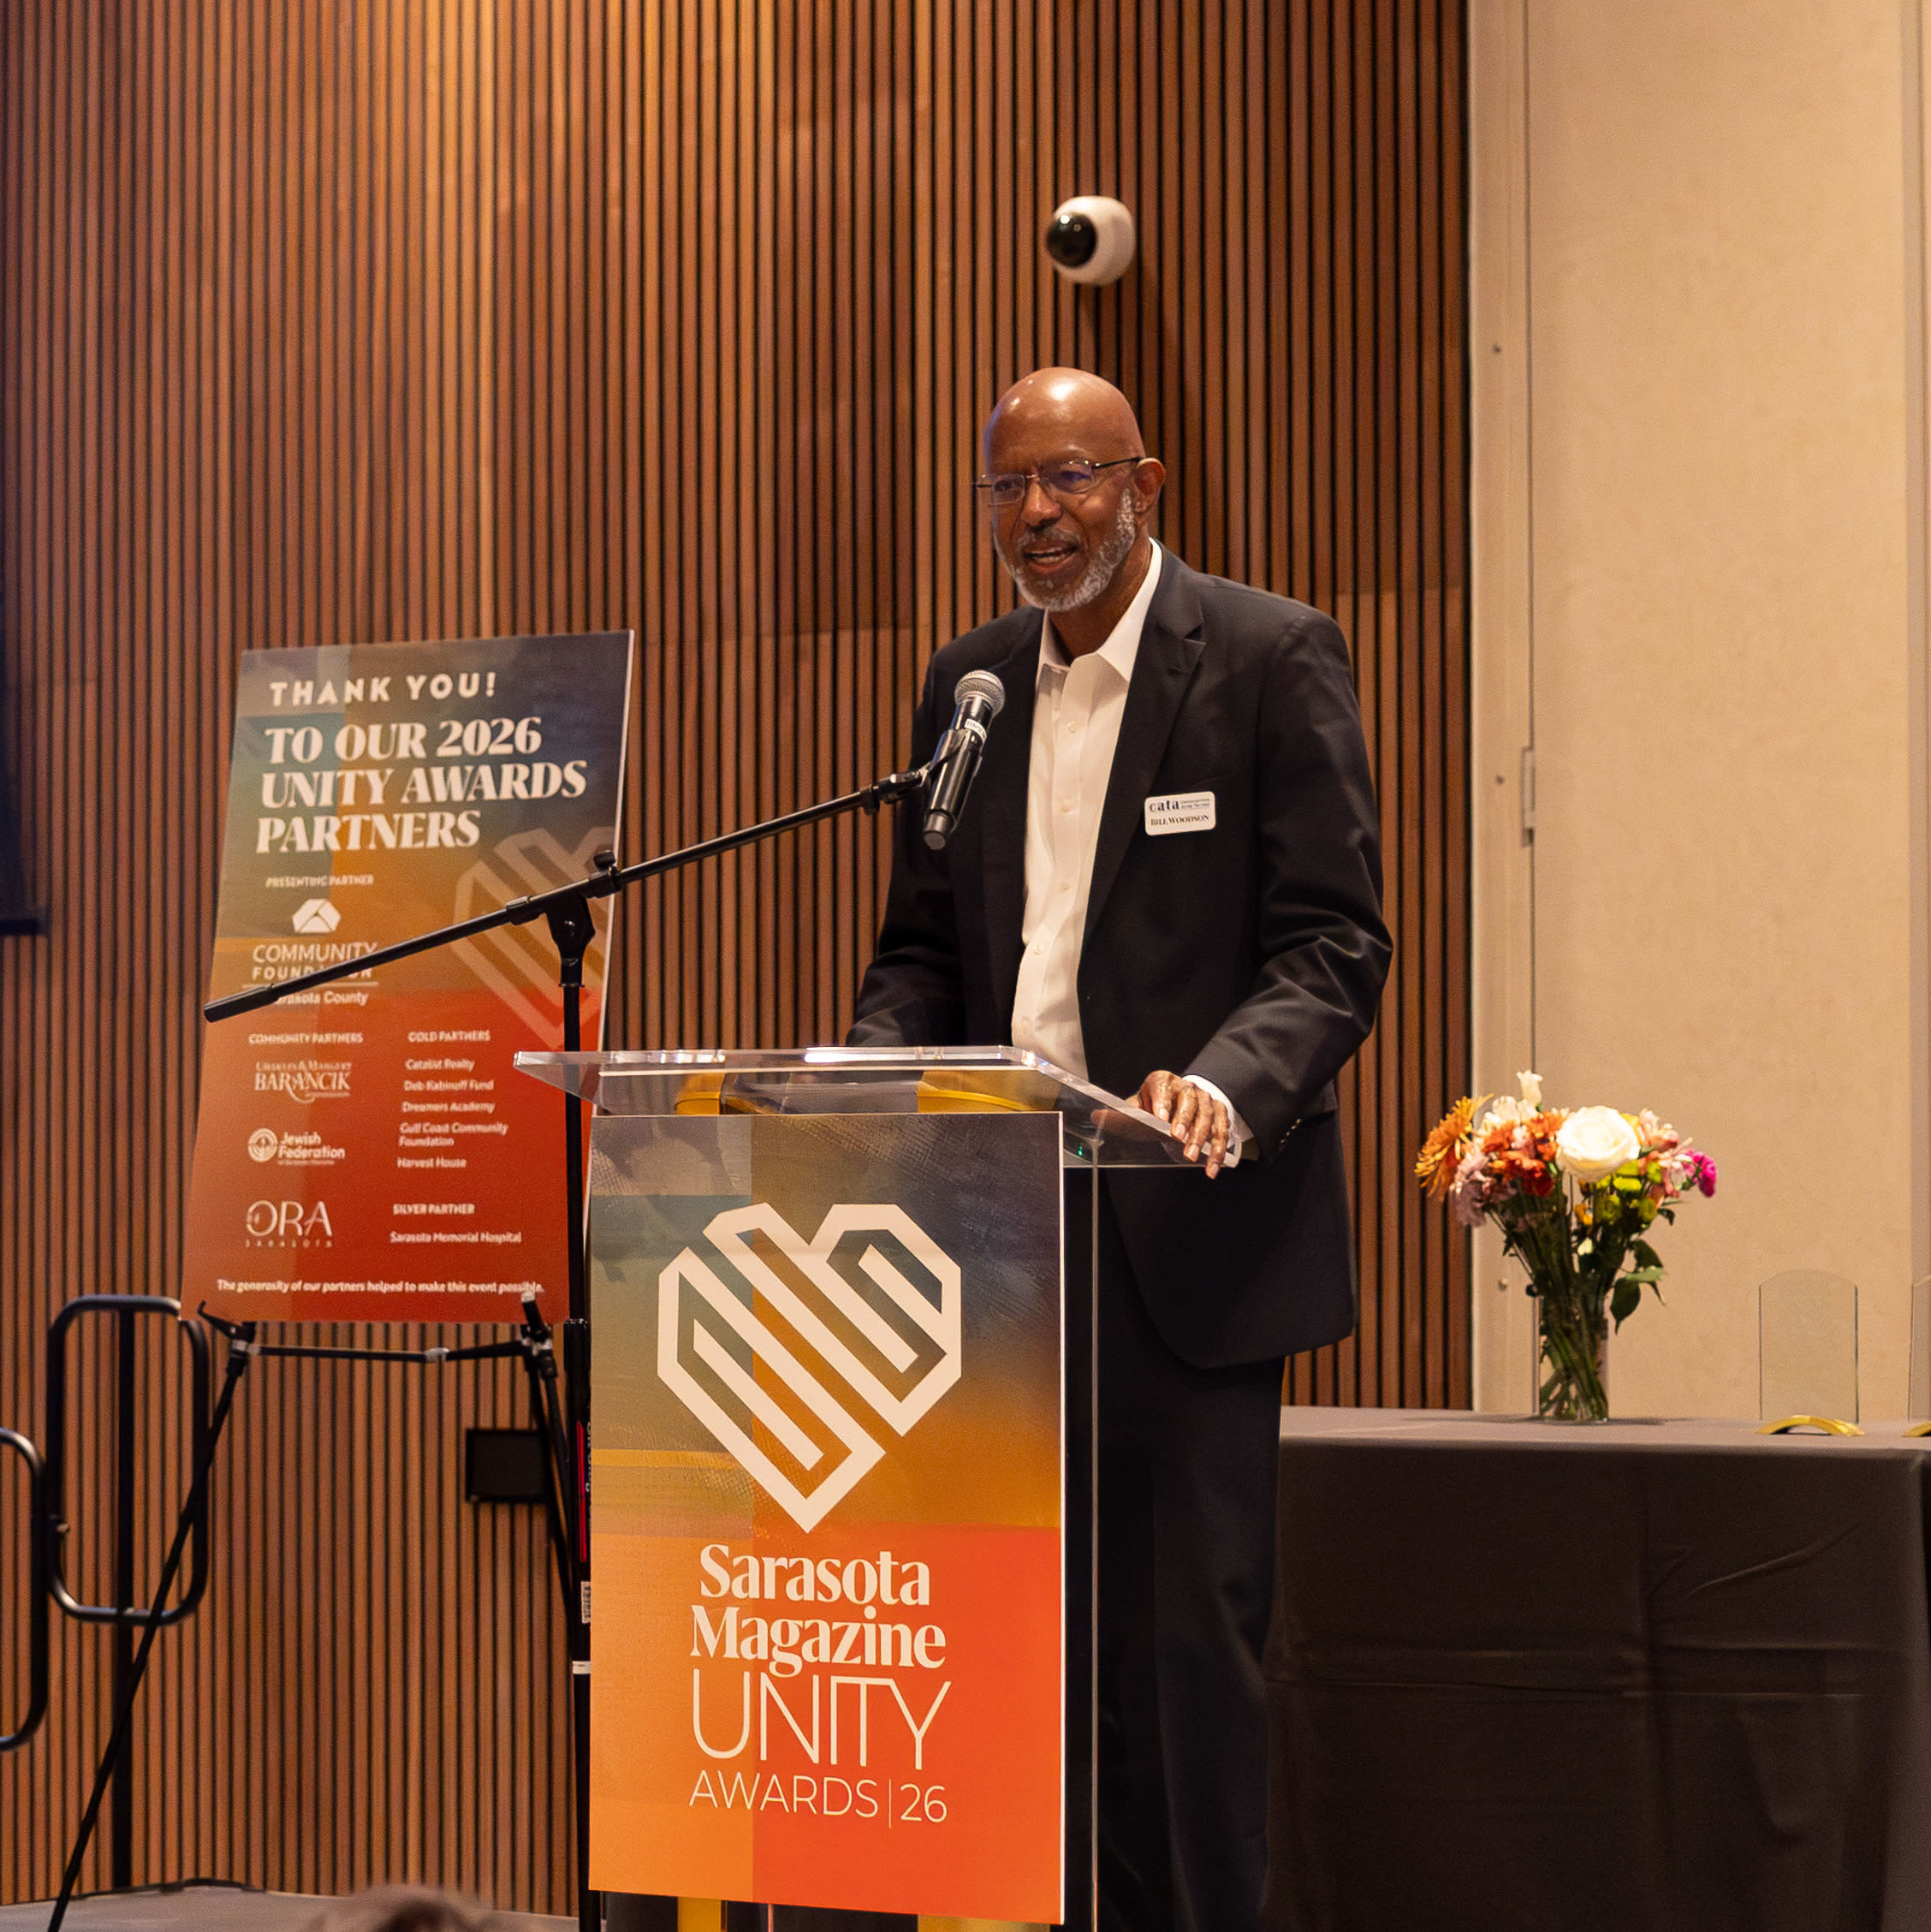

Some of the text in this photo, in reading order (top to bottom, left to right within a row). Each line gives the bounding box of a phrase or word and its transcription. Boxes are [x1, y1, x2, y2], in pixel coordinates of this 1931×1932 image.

[270, 672, 496, 706] THANK YOU!
[264, 716, 542, 764] TO OUR 2026
[262, 760, 587, 808] UNITY AWARDS
[257, 810, 480, 853] PARTNERS
[330, 874, 374, 886] PARTNER
[253, 942, 377, 963] COMMUNITY
[323, 990, 369, 1006] County
[248, 1031, 364, 1044] COMMUNITY PARTNERS
[407, 1030, 490, 1043] GOLD PARTNERS
[254, 1070, 351, 1103] BARANCIK
[469, 1079, 494, 1091] Fund
[449, 1101, 496, 1114] Academy
[399, 1121, 509, 1136] Gulf Coast Community
[281, 1131, 322, 1145] Jewish
[398, 1136, 455, 1147] Foundation
[278, 1145, 346, 1159] Federation
[397, 1156, 467, 1168] Harvest House
[393, 1204, 475, 1215] SILVER PARTNER
[247, 1200, 333, 1236] ORA
[390, 1231, 522, 1244] Sarasota Memorial Hospital
[217, 1279, 235, 1291] The
[236, 1280, 288, 1293] generosity
[290, 1280, 302, 1291] of
[303, 1282, 320, 1292] our
[322, 1281, 365, 1294] partners
[366, 1280, 403, 1293] helped
[404, 1281, 416, 1293] to
[418, 1281, 446, 1292] make
[447, 1281, 466, 1293] this
[468, 1281, 497, 1293] event
[699, 1543, 930, 1607] Sarasota
[689, 1604, 947, 1678] Magazine
[692, 1668, 952, 1770] UNITY
[689, 1769, 948, 1823] AWARDS 26
